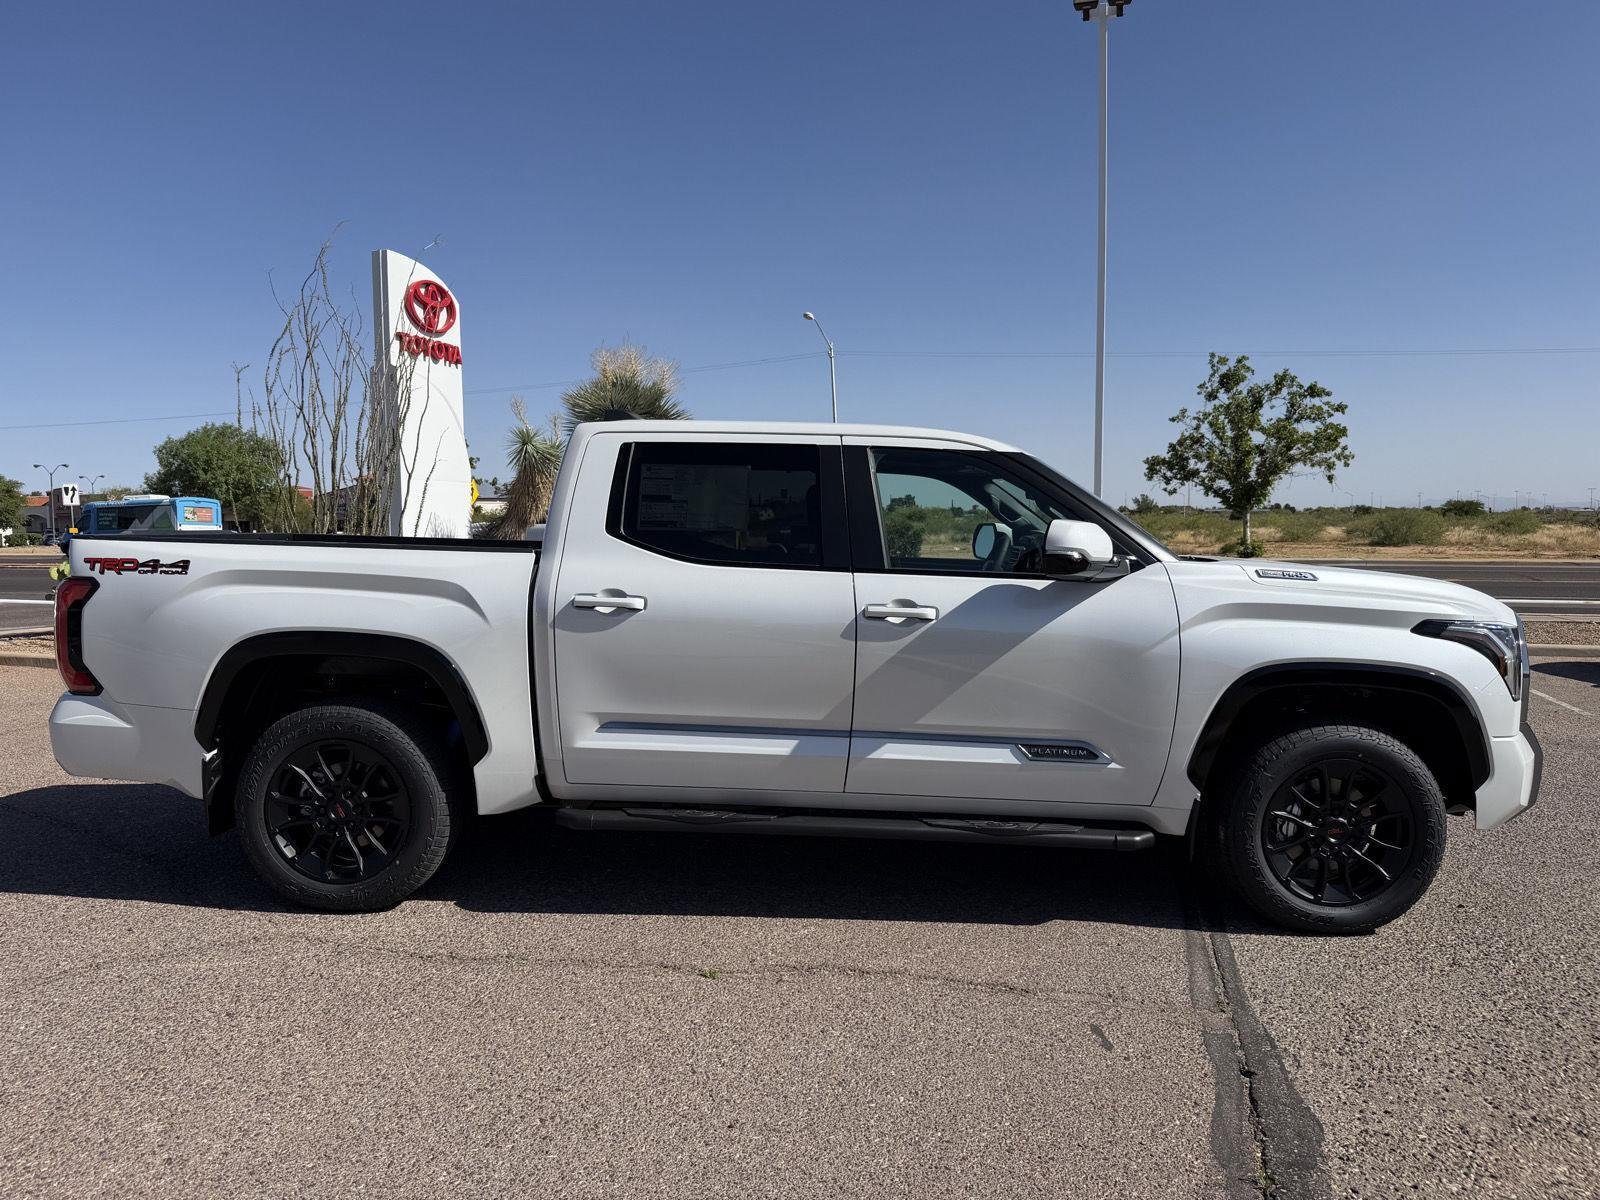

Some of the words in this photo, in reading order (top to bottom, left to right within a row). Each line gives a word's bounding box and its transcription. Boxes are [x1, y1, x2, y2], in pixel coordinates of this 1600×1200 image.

[395, 332, 462, 365] TOYOTA
[84, 558, 140, 575] TRD
[1030, 748, 1087, 756] PLATINUM
